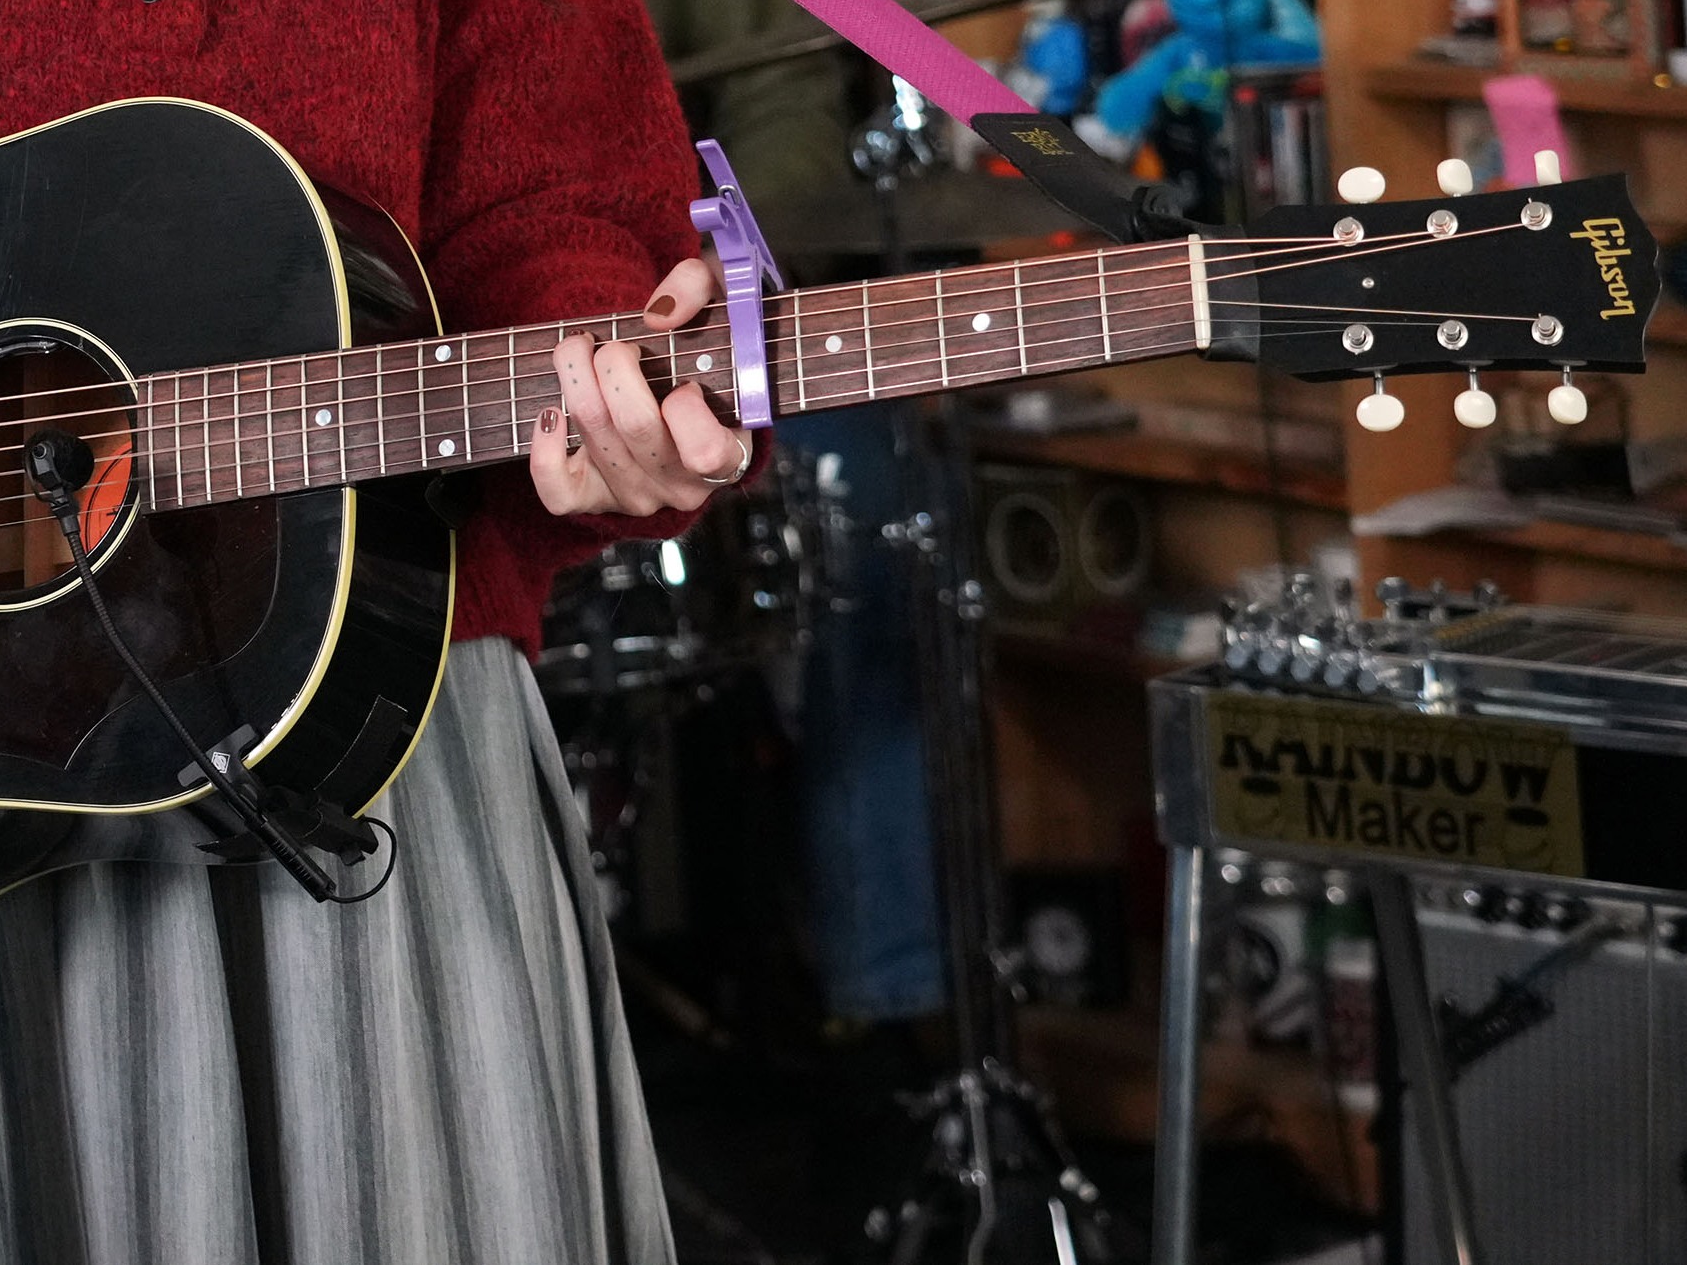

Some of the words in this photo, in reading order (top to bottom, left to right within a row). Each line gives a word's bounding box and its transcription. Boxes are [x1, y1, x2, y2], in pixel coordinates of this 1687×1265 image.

[1569, 218, 1635, 320] Gibson
[1219, 732, 1551, 803] RAINBOW
[1304, 780, 1487, 856] Maker
